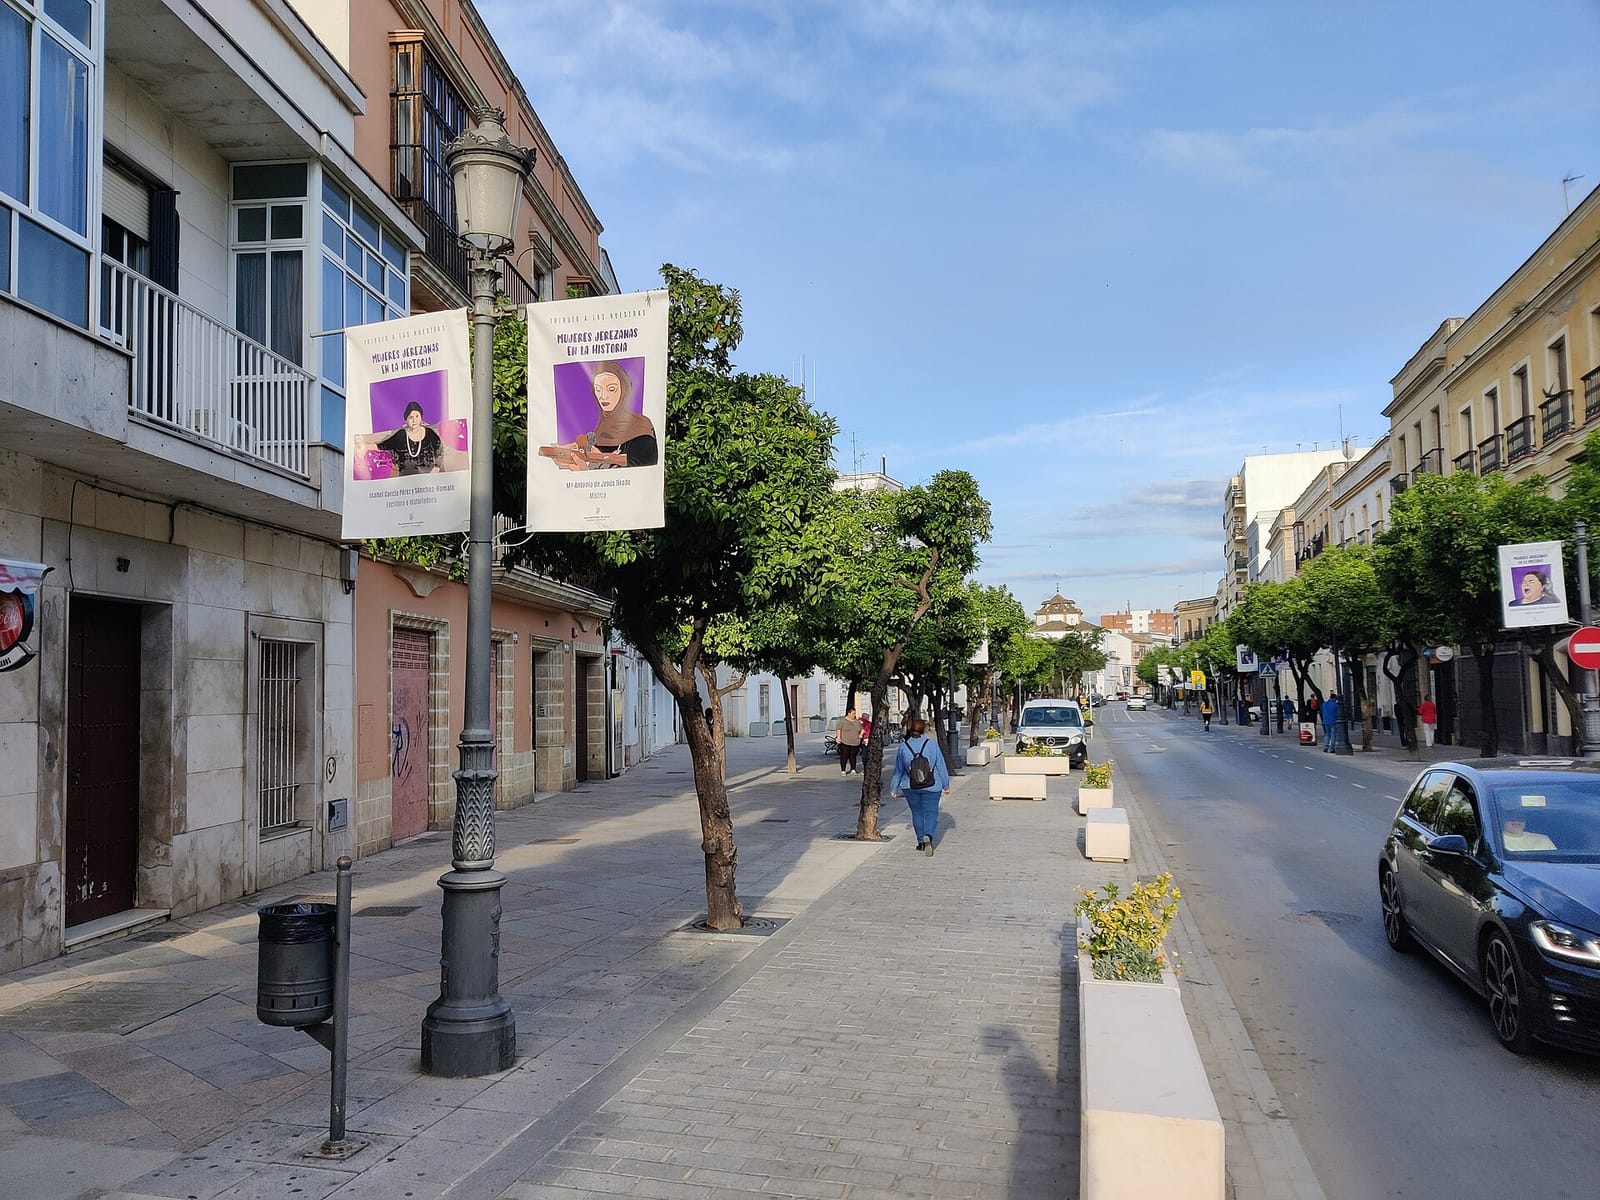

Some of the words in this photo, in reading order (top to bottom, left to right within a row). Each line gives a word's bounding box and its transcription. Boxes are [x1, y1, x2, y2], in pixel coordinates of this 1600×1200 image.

[557, 332, 592, 344] MUJERES
[595, 327, 638, 341] JEREZANAS
[372, 350, 400, 364] MUJERES
[402, 343, 439, 358] JEREZANAS
[567, 345, 577, 356] EN
[580, 344, 589, 355] LA
[592, 342, 628, 354] HISTORIA
[381, 364, 389, 375] EN
[391, 363, 399, 372] LA
[401, 357, 432, 370] HISTORIA
